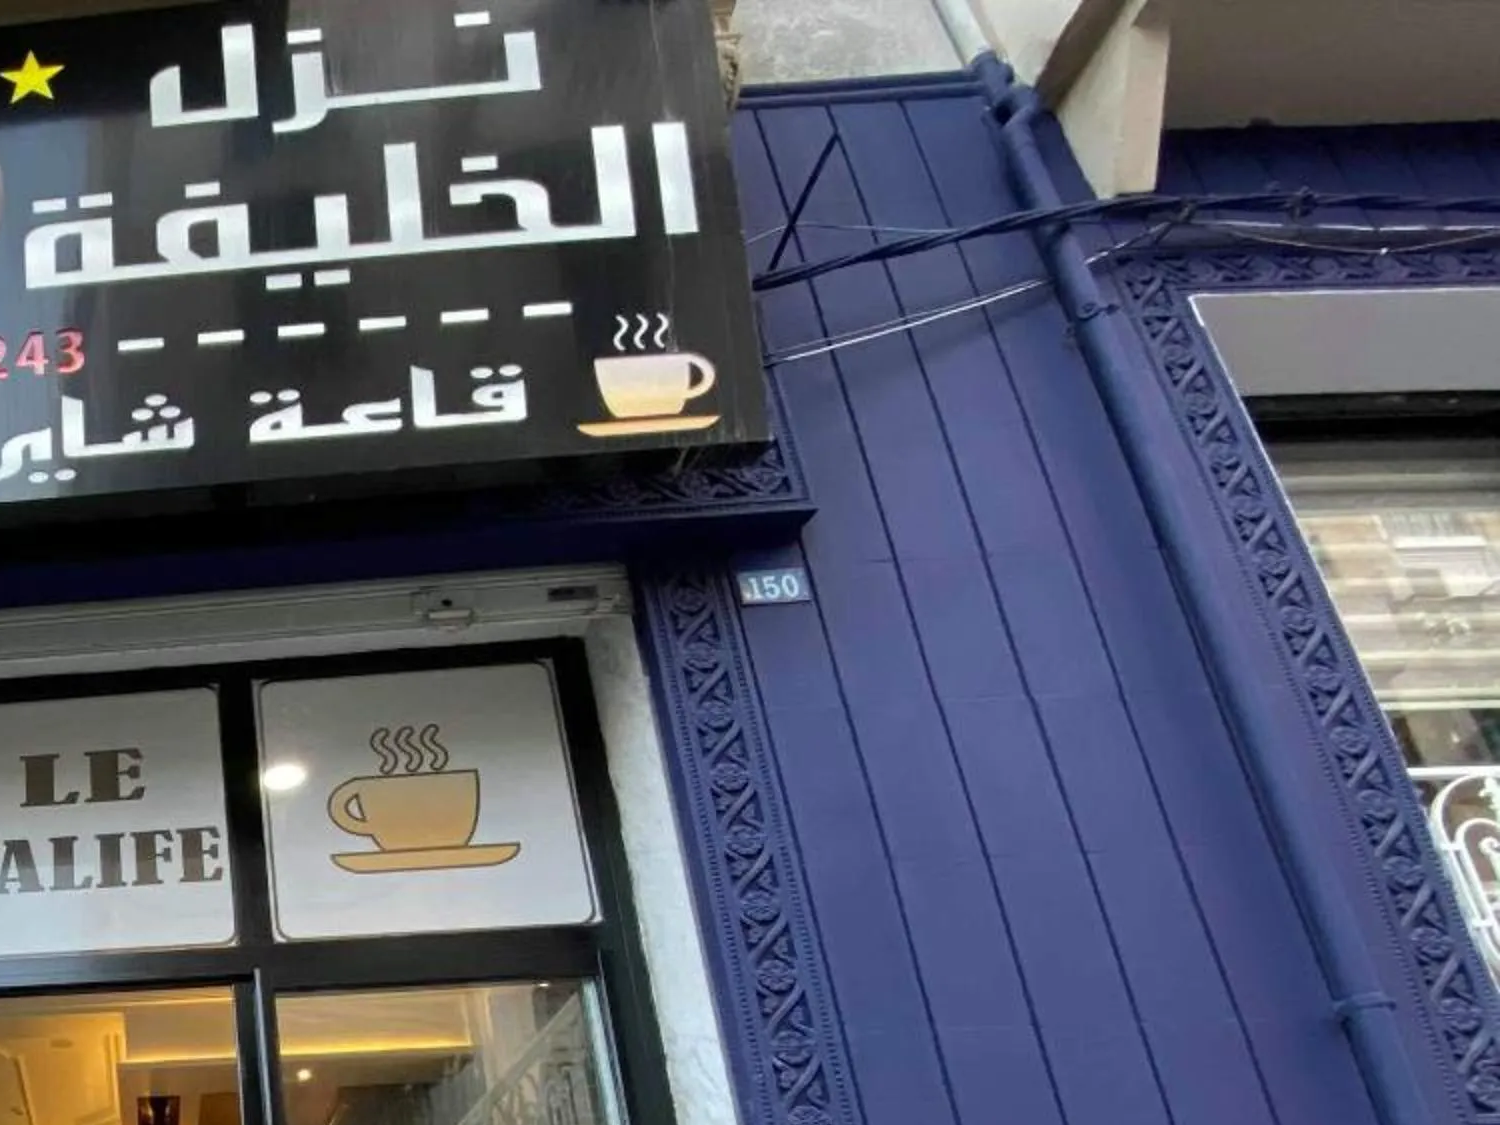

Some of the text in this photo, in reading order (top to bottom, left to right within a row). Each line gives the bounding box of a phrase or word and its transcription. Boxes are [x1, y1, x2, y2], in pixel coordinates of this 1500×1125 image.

[24, 121, 700, 290] الخليفة
[249, 364, 528, 444] قاعة
[747, 574, 799, 599] 150
[19, 747, 146, 808] LE
